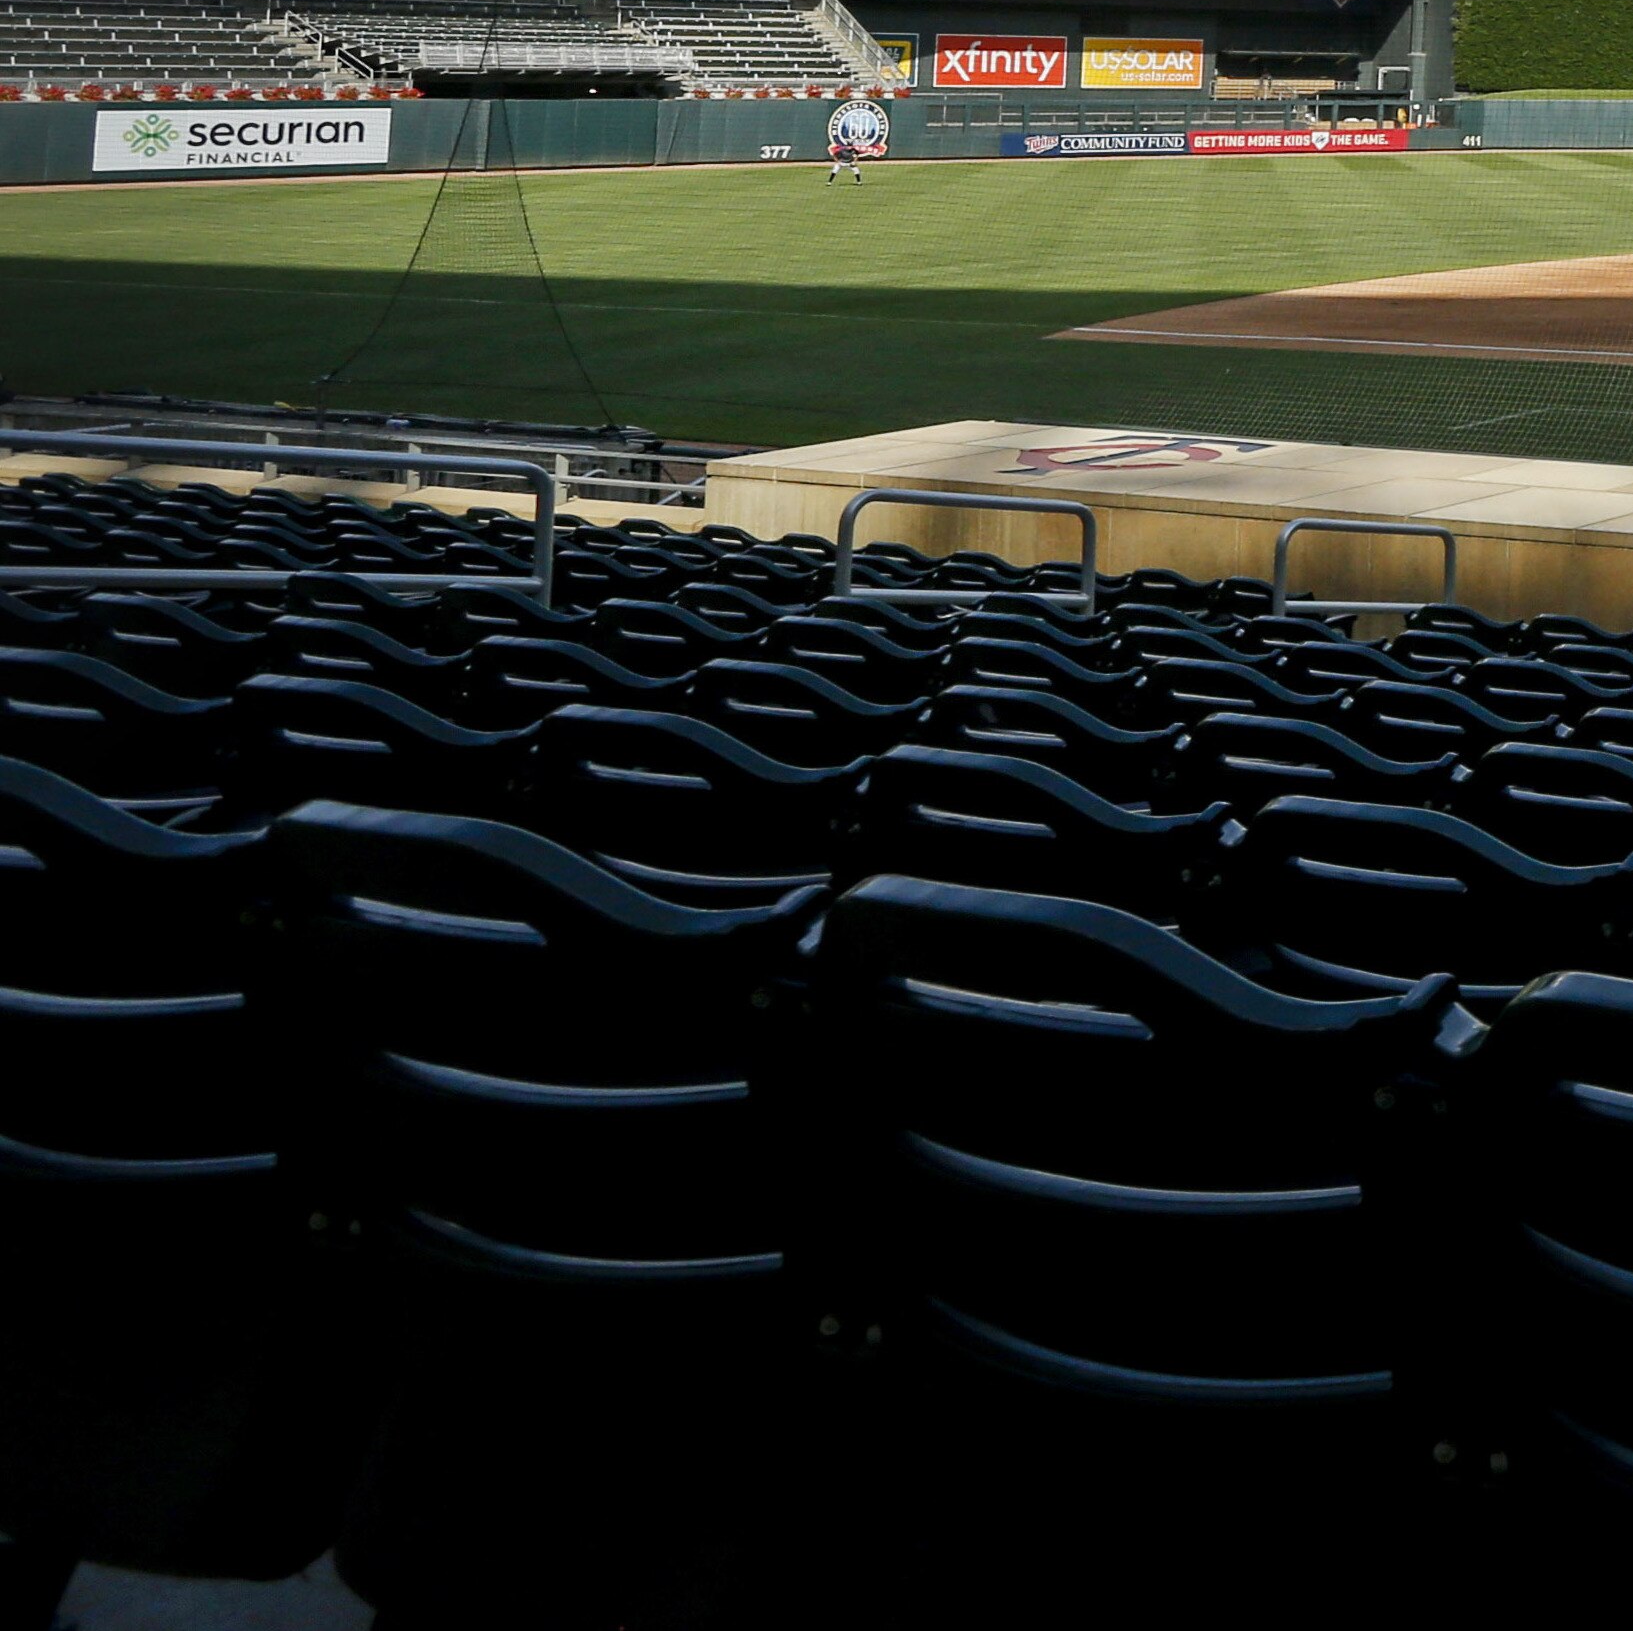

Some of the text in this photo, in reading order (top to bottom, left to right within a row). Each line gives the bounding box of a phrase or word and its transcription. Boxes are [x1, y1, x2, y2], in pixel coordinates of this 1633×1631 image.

[942, 41, 1060, 81] xfinity
[1121, 71, 1194, 82] us-solar.com
[187, 119, 364, 148] securian
[1194, 133, 1389, 148] GETTING MORE KIDS THE GAME.
[1462, 135, 1482, 147] 411
[1060, 136, 1148, 151] COMMUNITY
[1148, 135, 1185, 148] FUND
[187, 150, 296, 166] FINANCIAL
[760, 145, 792, 159] 377
